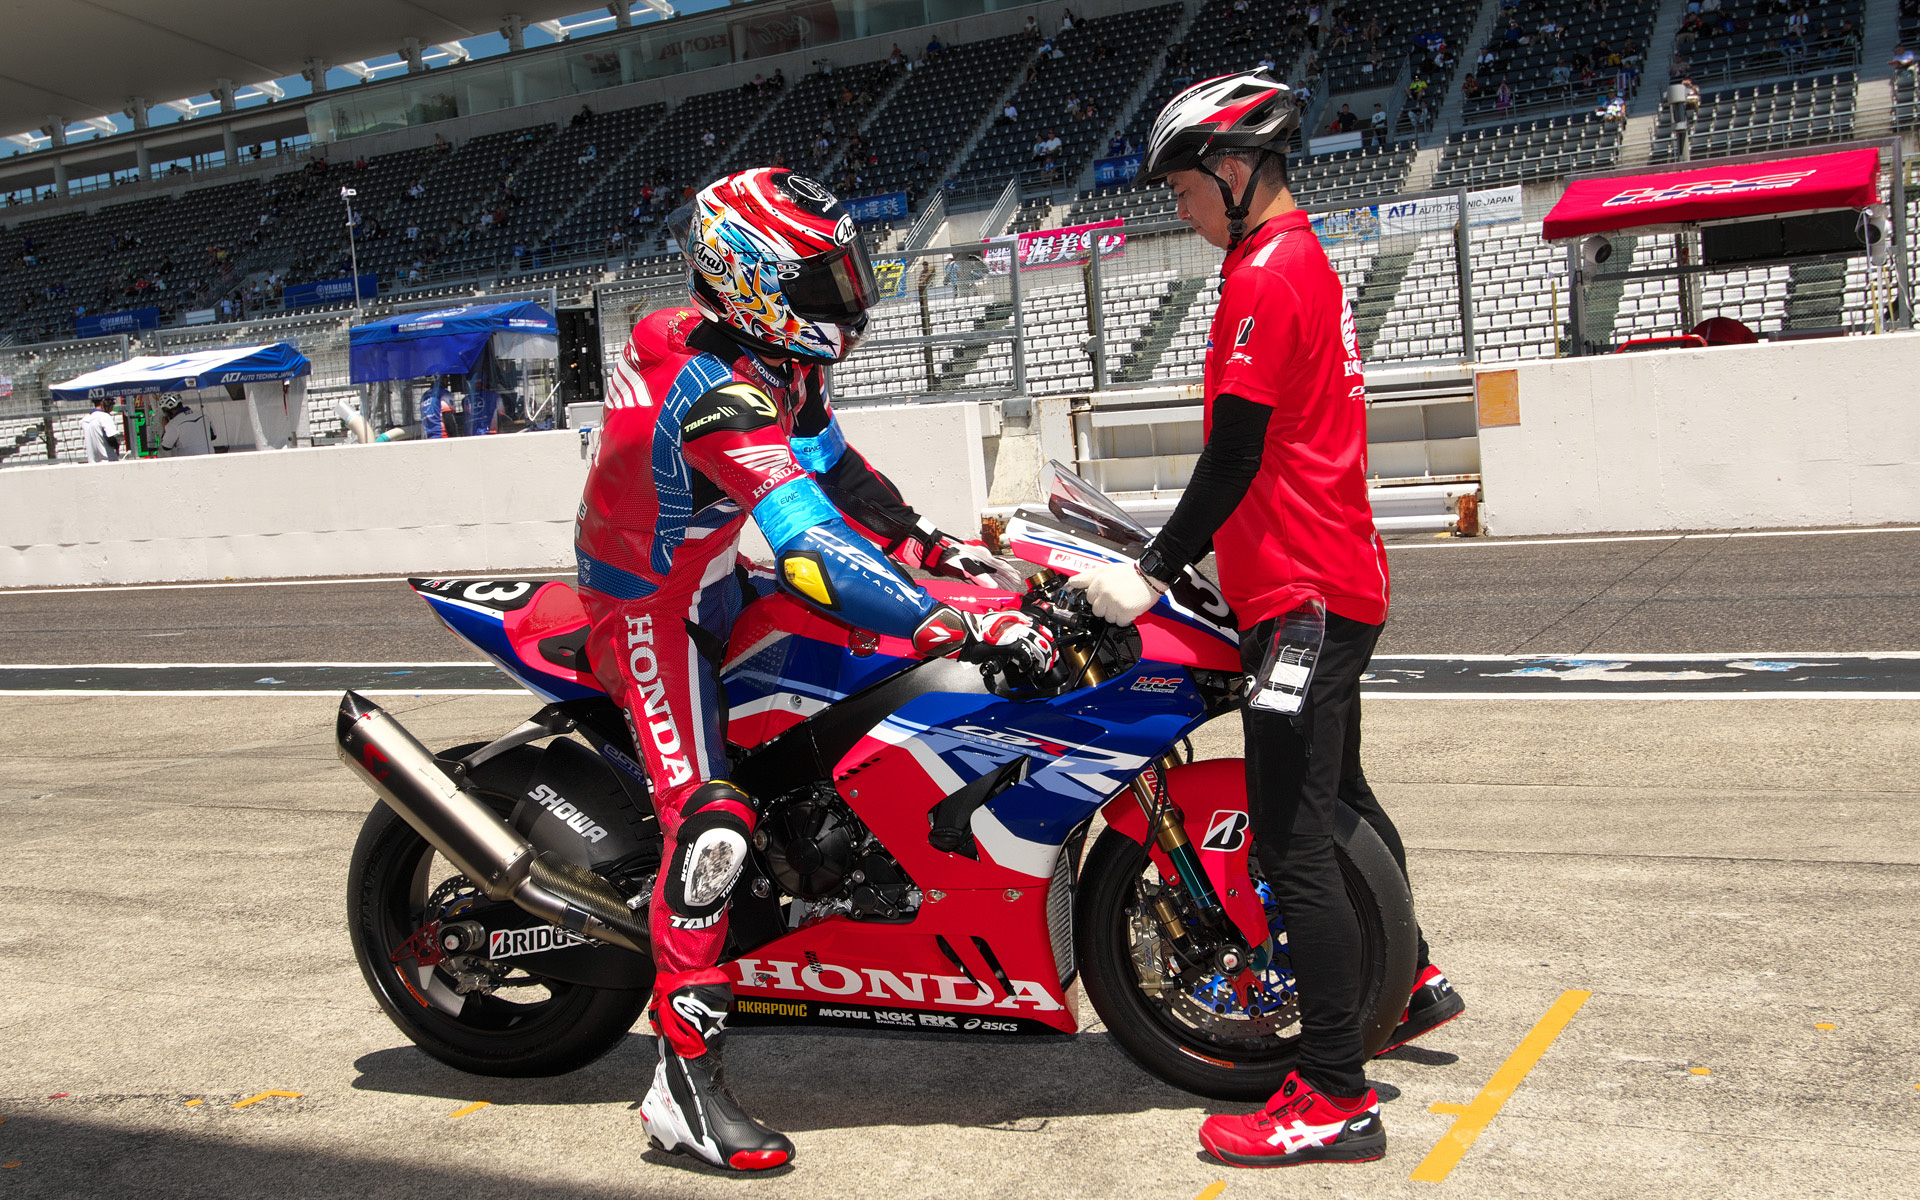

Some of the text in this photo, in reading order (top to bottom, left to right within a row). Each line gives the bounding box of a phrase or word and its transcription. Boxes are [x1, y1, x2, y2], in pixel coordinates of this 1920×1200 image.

[1387, 195, 1515, 219] ATJ AUTO TECNIC JAPAN
[697, 246, 721, 271] Arai
[221, 372, 241, 383] ATJ
[751, 358, 781, 388] HONDA
[88, 387, 105, 399] ATJ
[684, 412, 721, 433] TAICHI
[803, 444, 822, 453] EWC
[752, 462, 803, 499] HONDA
[780, 491, 800, 505] EWC
[804, 536, 905, 603] FIREBLADE
[463, 580, 531, 602] 3
[625, 613, 693, 788] HONDA
[527, 784, 608, 844] SHOWA
[681, 842, 694, 883] TAICHI
[720, 864, 743, 899] TAICHI
[669, 900, 729, 930] TAIC
[735, 958, 1065, 1012] HONDA
[819, 1008, 871, 1020] MOTUL
[874, 1011, 915, 1022] NGK
[919, 1013, 959, 1026] RK
[981, 1021, 1018, 1032] asics
